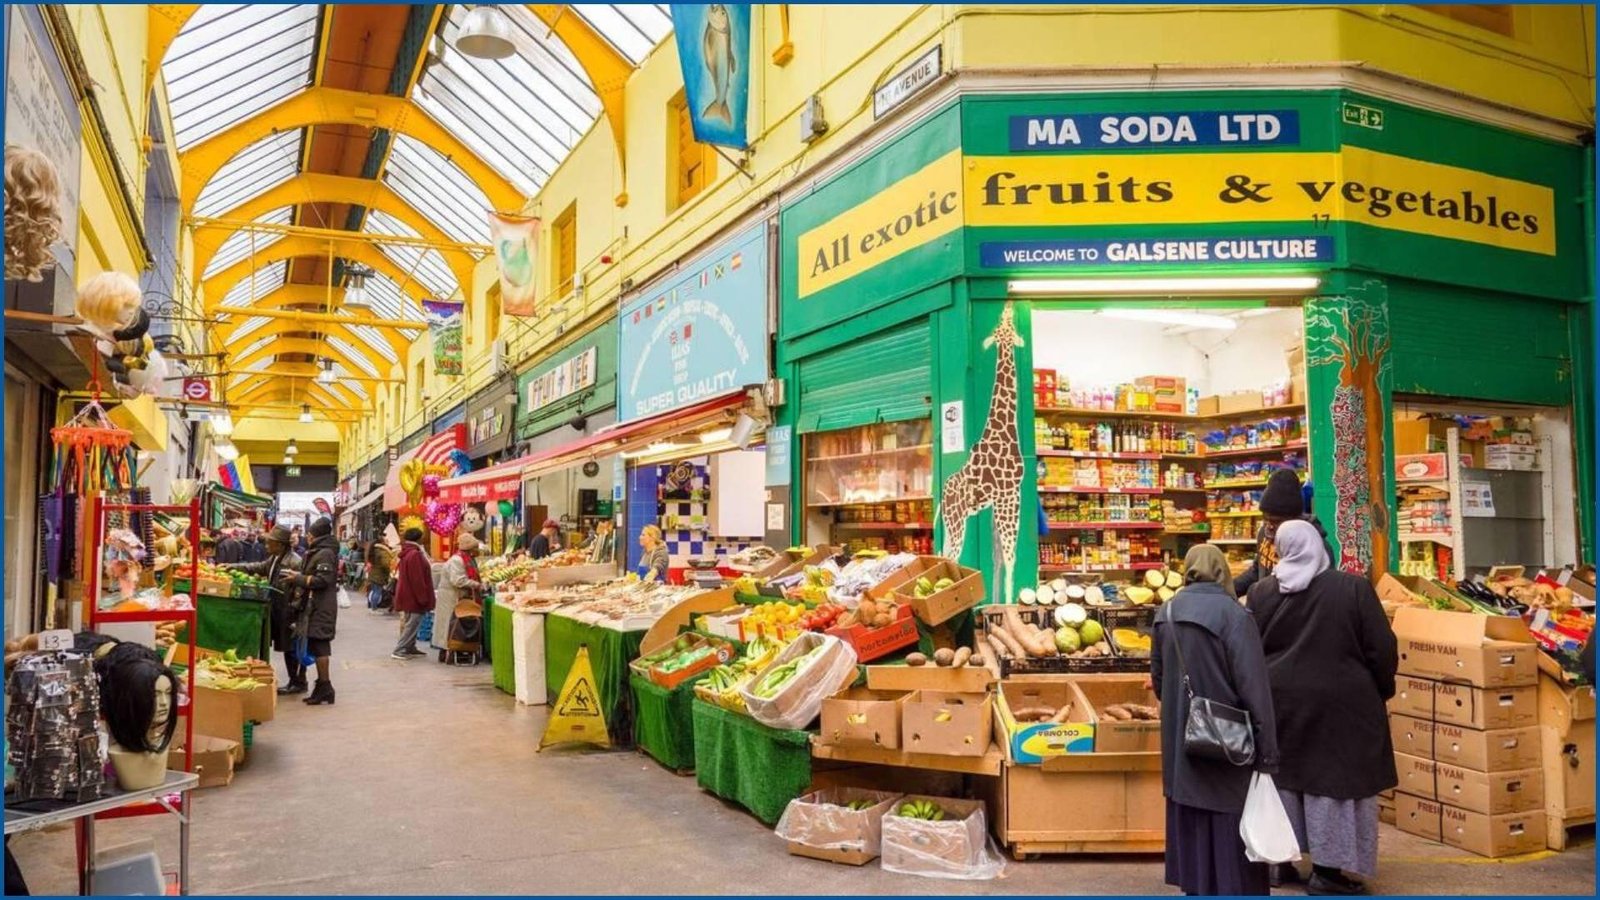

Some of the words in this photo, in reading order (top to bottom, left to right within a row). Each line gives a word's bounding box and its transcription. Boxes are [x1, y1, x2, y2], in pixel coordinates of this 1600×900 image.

[894, 61, 932, 96] AVENUE
[1027, 118, 1081, 145] MA
[1100, 115, 1197, 144] SODA
[1219, 114, 1281, 142] LTD
[811, 233, 851, 278] All
[860, 191, 957, 254] exotic
[981, 171, 1174, 206] fruits
[1219, 174, 1273, 204] &
[1296, 180, 1539, 235] vegetables
[1311, 213, 1331, 230] 17
[1004, 248, 1075, 263] WELCOME
[1077, 247, 1098, 261] TO
[1106, 241, 1210, 262] GALSENE
[1214, 239, 1317, 260] CULTURE
[636, 390, 675, 416] SUPER
[677, 368, 737, 401] QUALITY
[1409, 641, 1434, 653] FRESH
[1436, 644, 1458, 656] YAM
[1436, 684, 1457, 697] YAM
[1441, 725, 1462, 738] YAM
[1442, 767, 1464, 781] YAM
[1445, 807, 1467, 821] YAM
